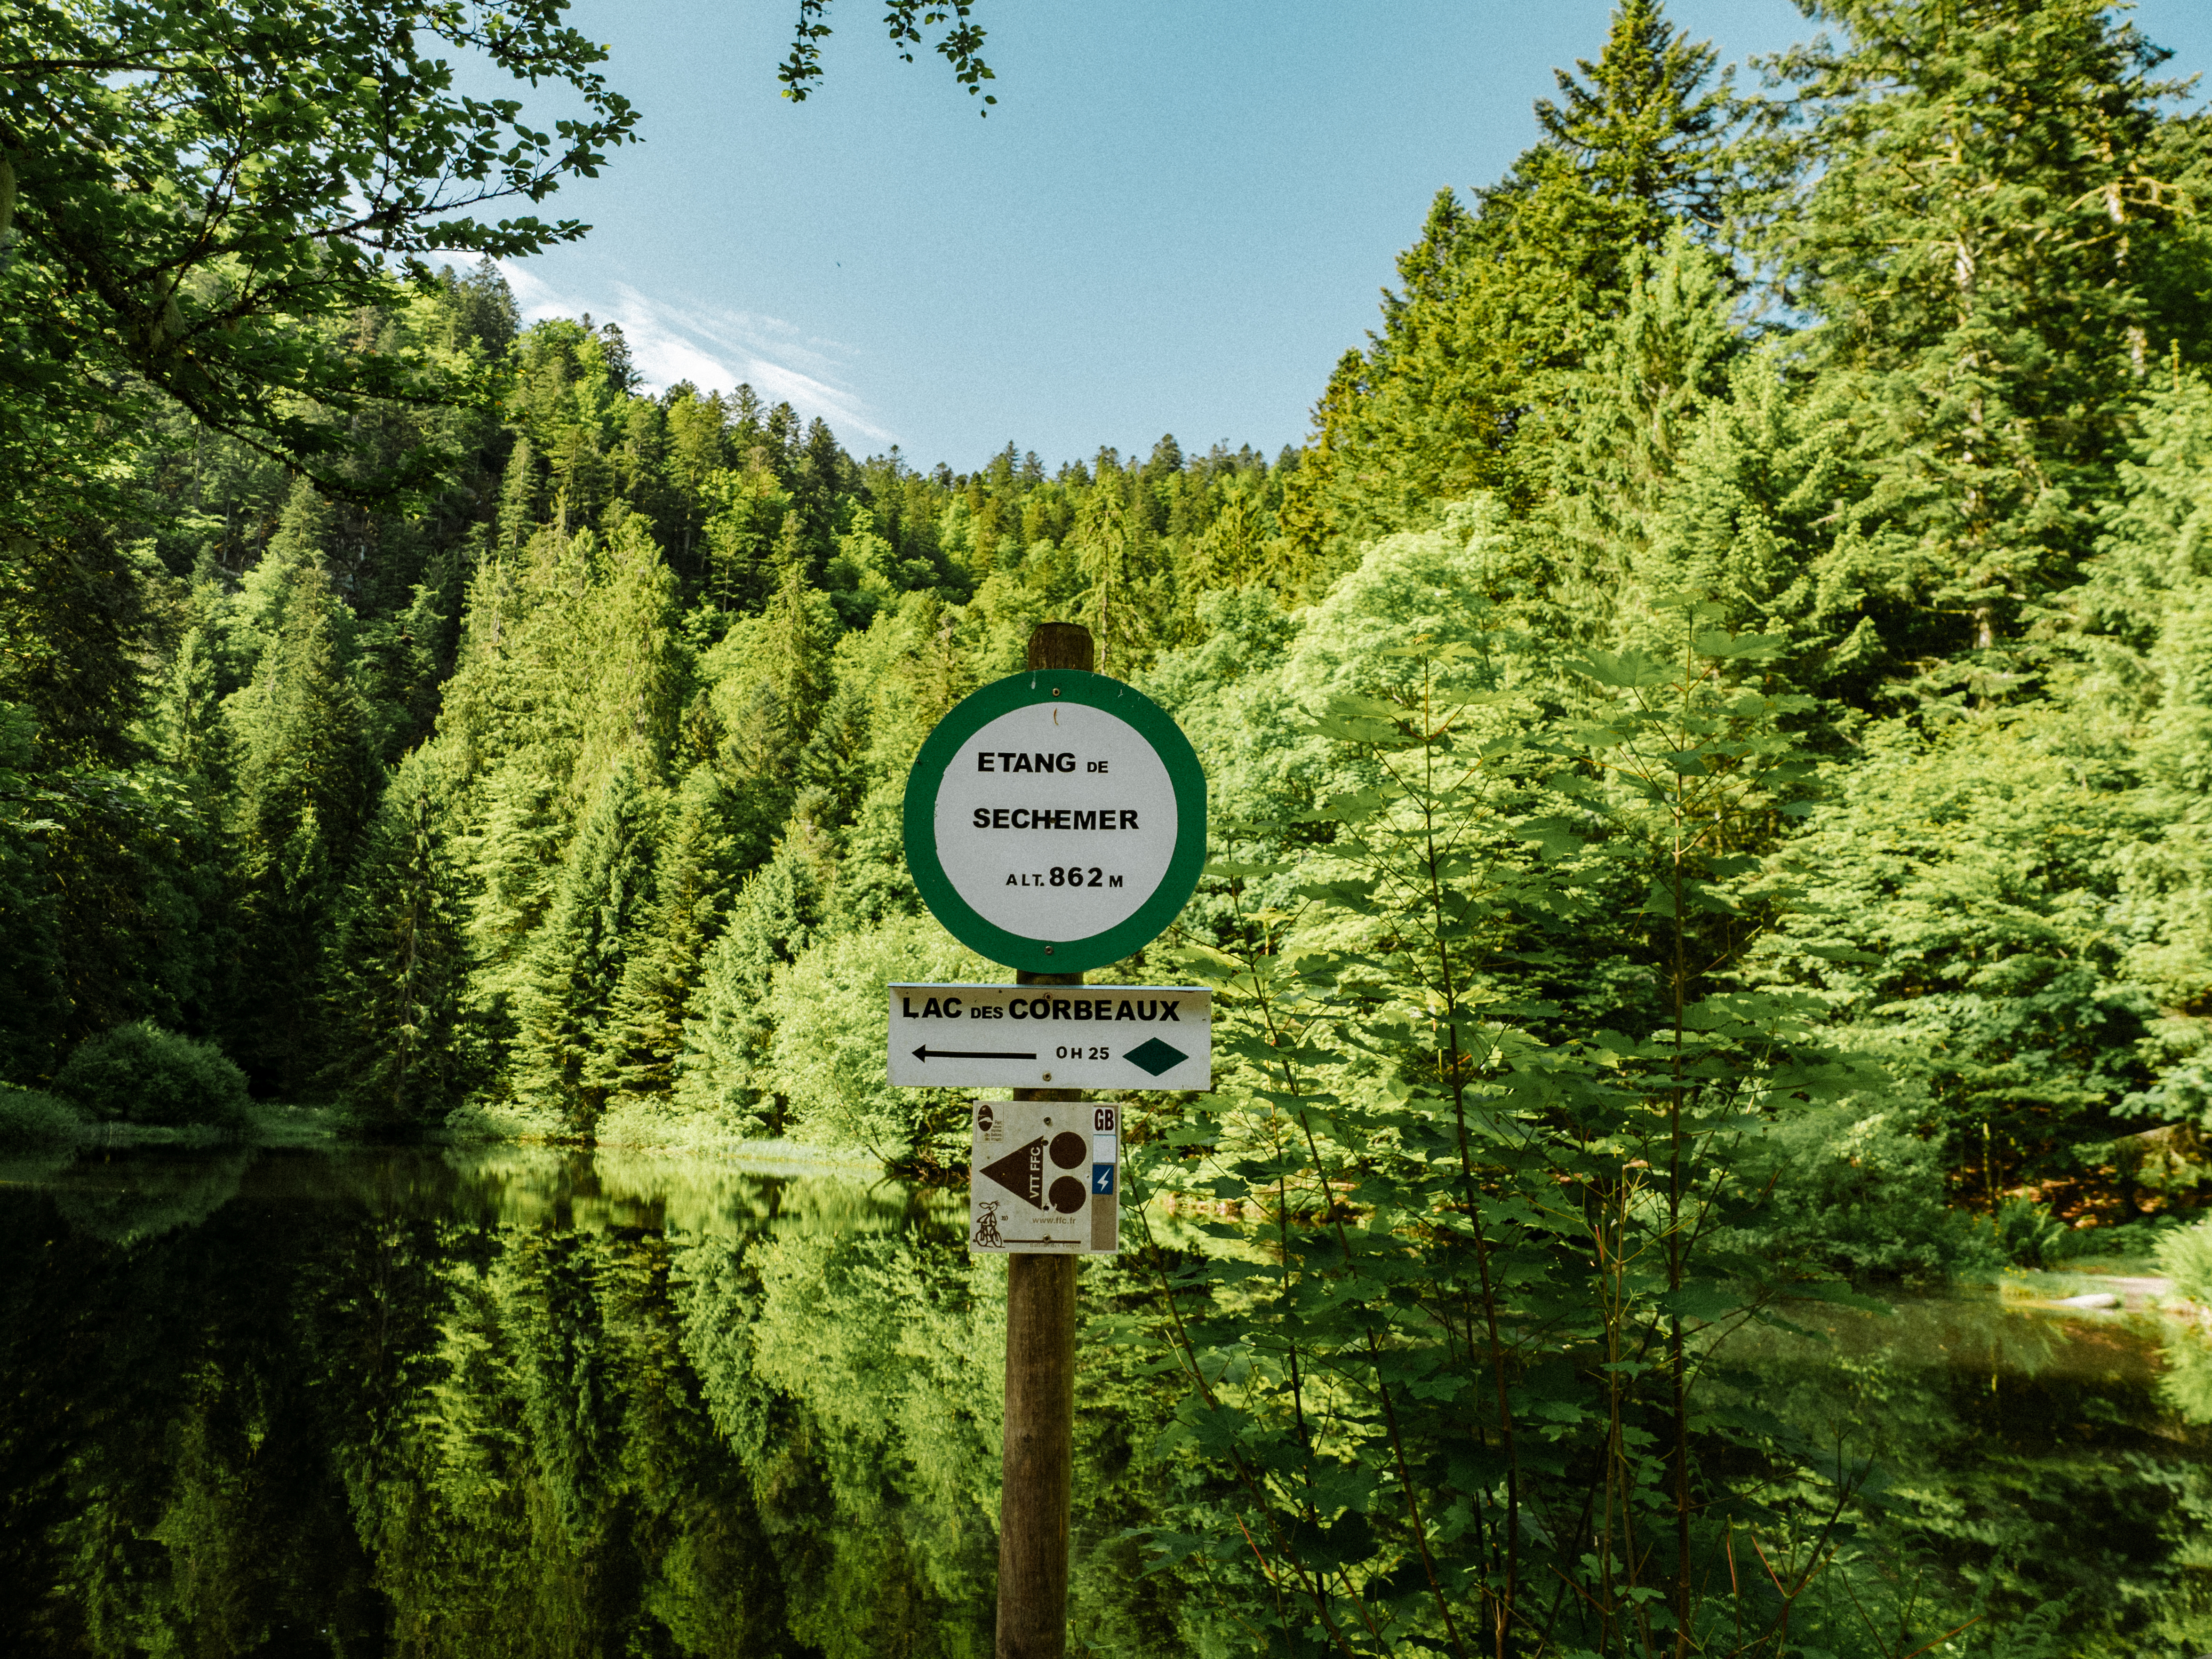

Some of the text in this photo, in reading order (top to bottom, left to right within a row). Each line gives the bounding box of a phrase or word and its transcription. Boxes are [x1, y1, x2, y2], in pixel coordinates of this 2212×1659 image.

[978, 752, 1109, 774] ETANG DE
[973, 808, 1139, 830] SECHEMER
[1006, 874, 1045, 887] ALT.
[1049, 867, 1102, 887] 862
[902, 997, 1181, 1021] LAC DES CORBEAUX
[1088, 1047, 1110, 1060] 25
[1094, 1108, 1114, 1131] GB
[1029, 1147, 1041, 1199] VTT FFC
